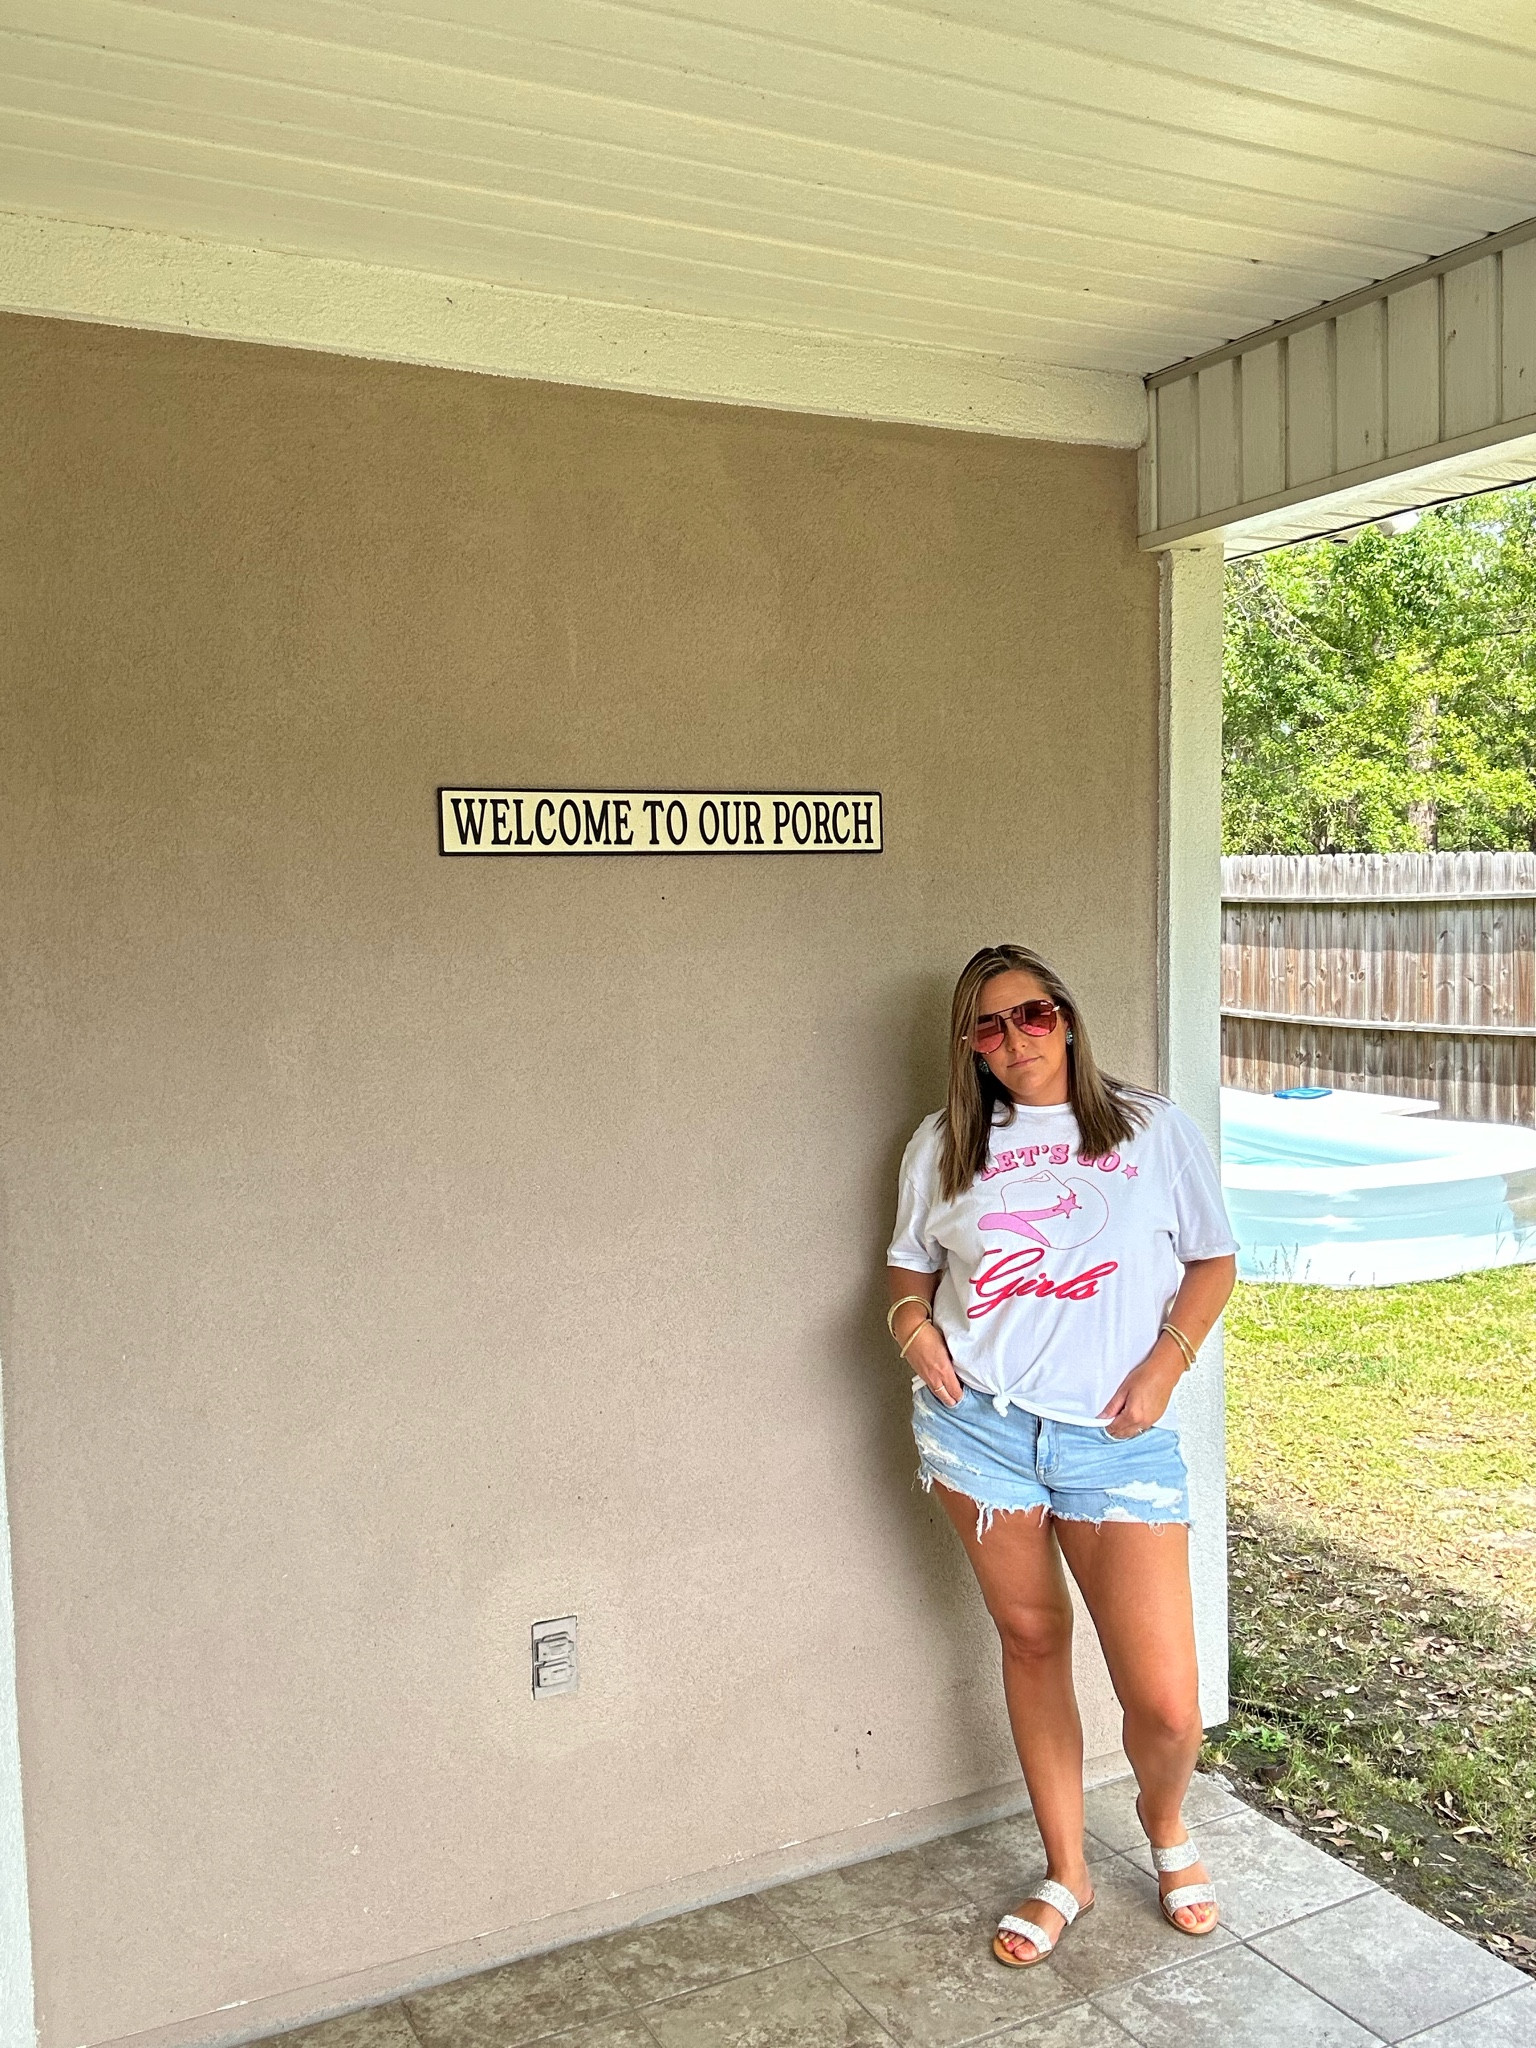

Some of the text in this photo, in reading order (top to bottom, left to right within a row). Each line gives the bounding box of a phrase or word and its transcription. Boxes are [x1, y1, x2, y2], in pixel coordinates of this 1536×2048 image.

[451, 798, 874, 846] WELCOME TO OUR PORCH
[967, 1247, 1118, 1319] Girls
